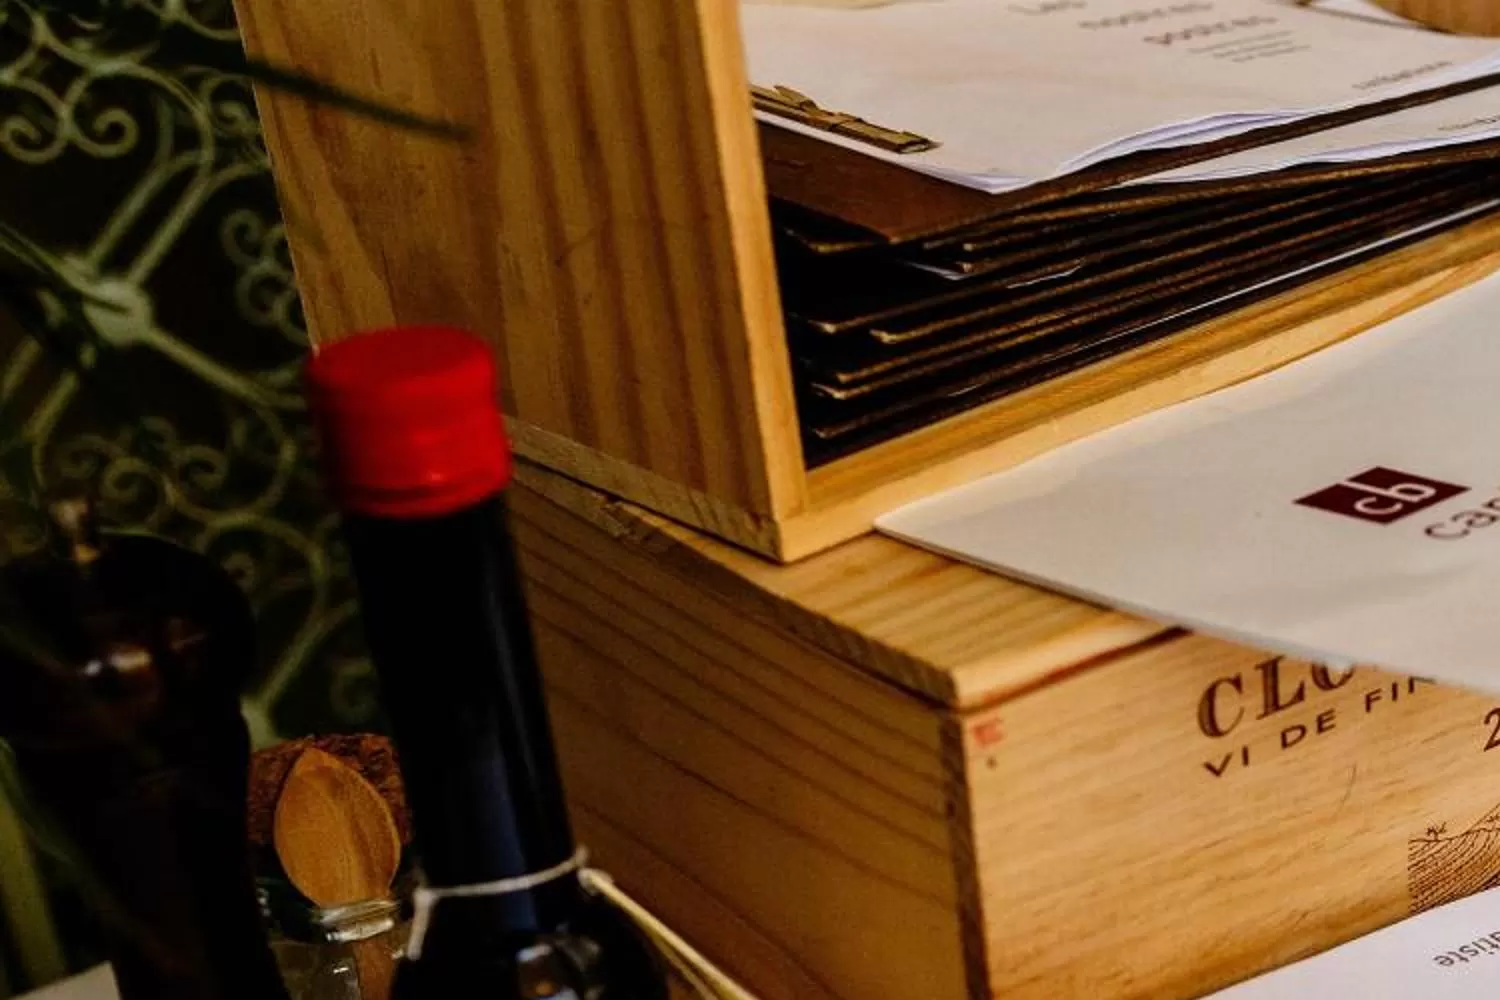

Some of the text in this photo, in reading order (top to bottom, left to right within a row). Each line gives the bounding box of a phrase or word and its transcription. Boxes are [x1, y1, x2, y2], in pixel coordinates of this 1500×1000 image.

[1196, 655, 1353, 739] CLO
[1203, 746, 1250, 778] VI
[1280, 710, 1337, 750] DE
